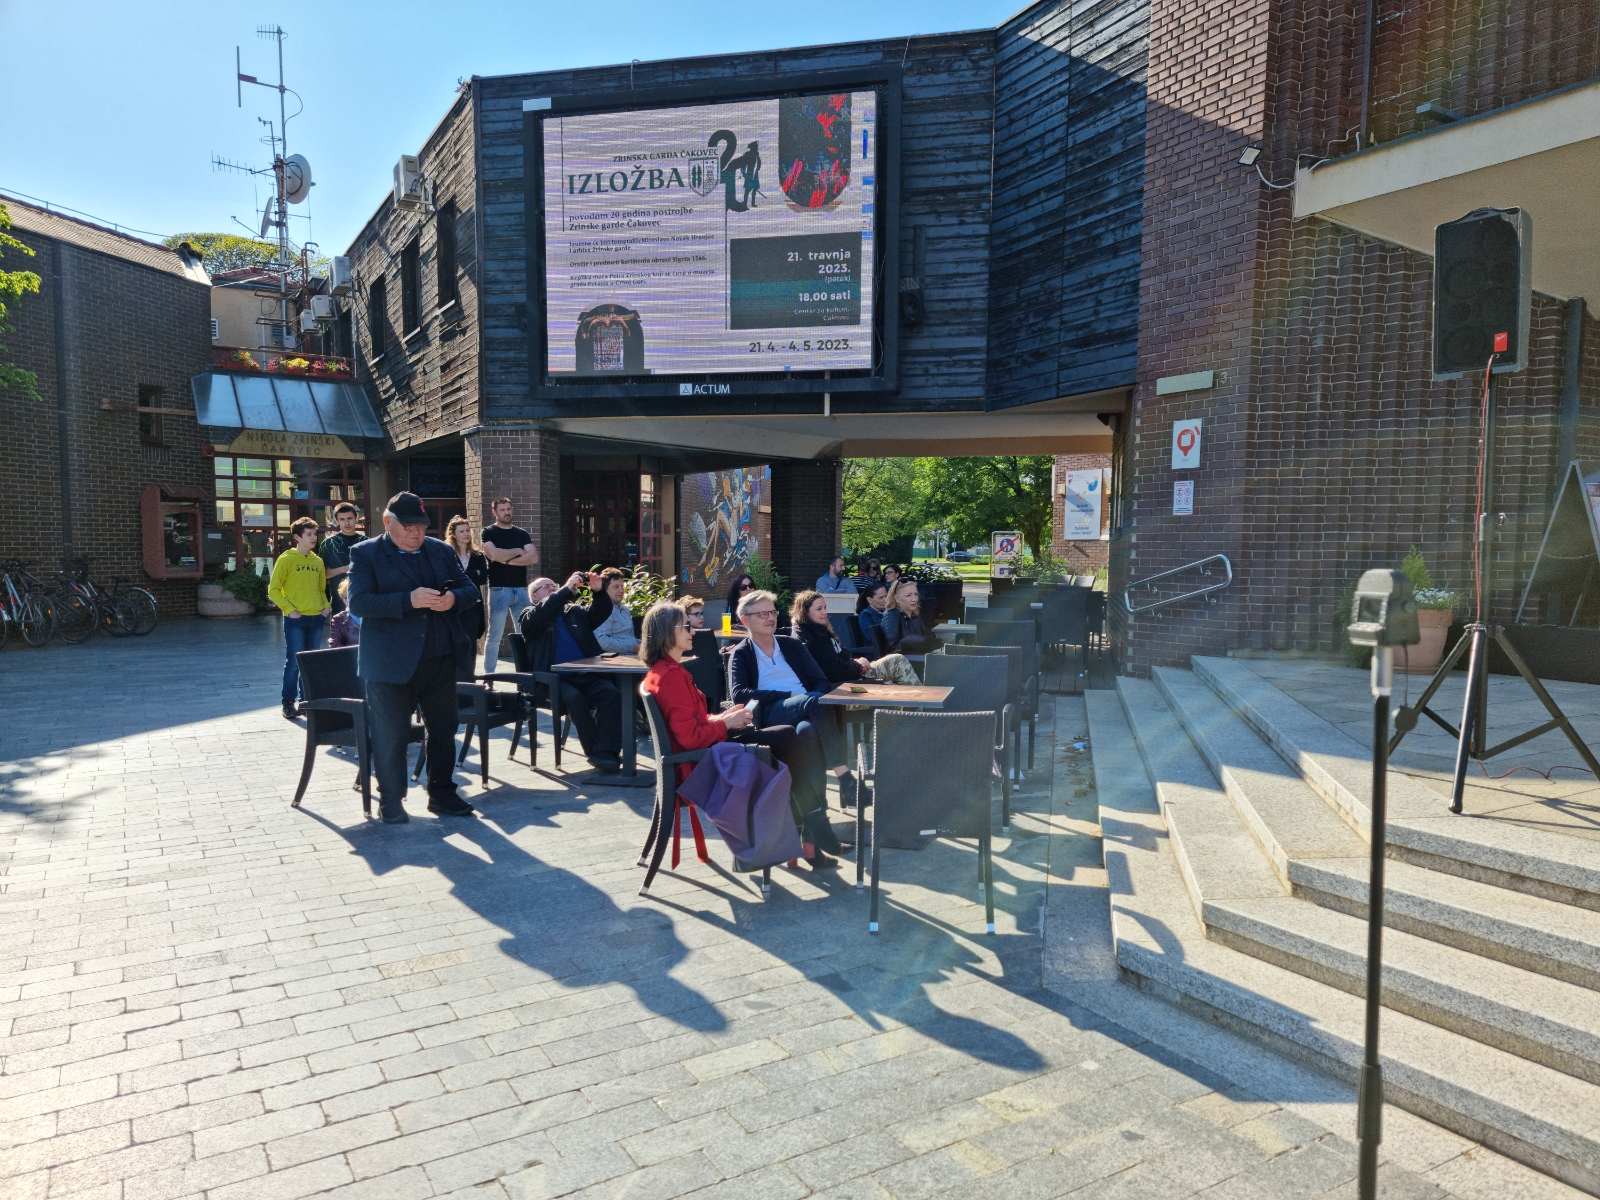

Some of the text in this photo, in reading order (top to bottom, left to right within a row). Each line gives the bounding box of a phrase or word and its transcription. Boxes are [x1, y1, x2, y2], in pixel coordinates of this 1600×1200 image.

[650, 152, 679, 160] GARDA
[567, 164, 686, 195] IZLOŽBA
[569, 213, 608, 222] povodom
[622, 210, 651, 219] godina
[653, 206, 693, 217] postrojbe
[569, 219, 662, 231] Zrinske garde Čakovec
[787, 248, 851, 262] 21. travnja
[818, 263, 851, 274] 2023.
[830, 290, 851, 300] sati
[749, 342, 765, 353] 21.
[767, 341, 778, 352] 4.
[788, 340, 800, 352] 4.
[803, 340, 814, 351] 5.
[817, 339, 853, 351] 2023.
[693, 383, 731, 395] ACTUM
[246, 431, 288, 442] NIKOLA
